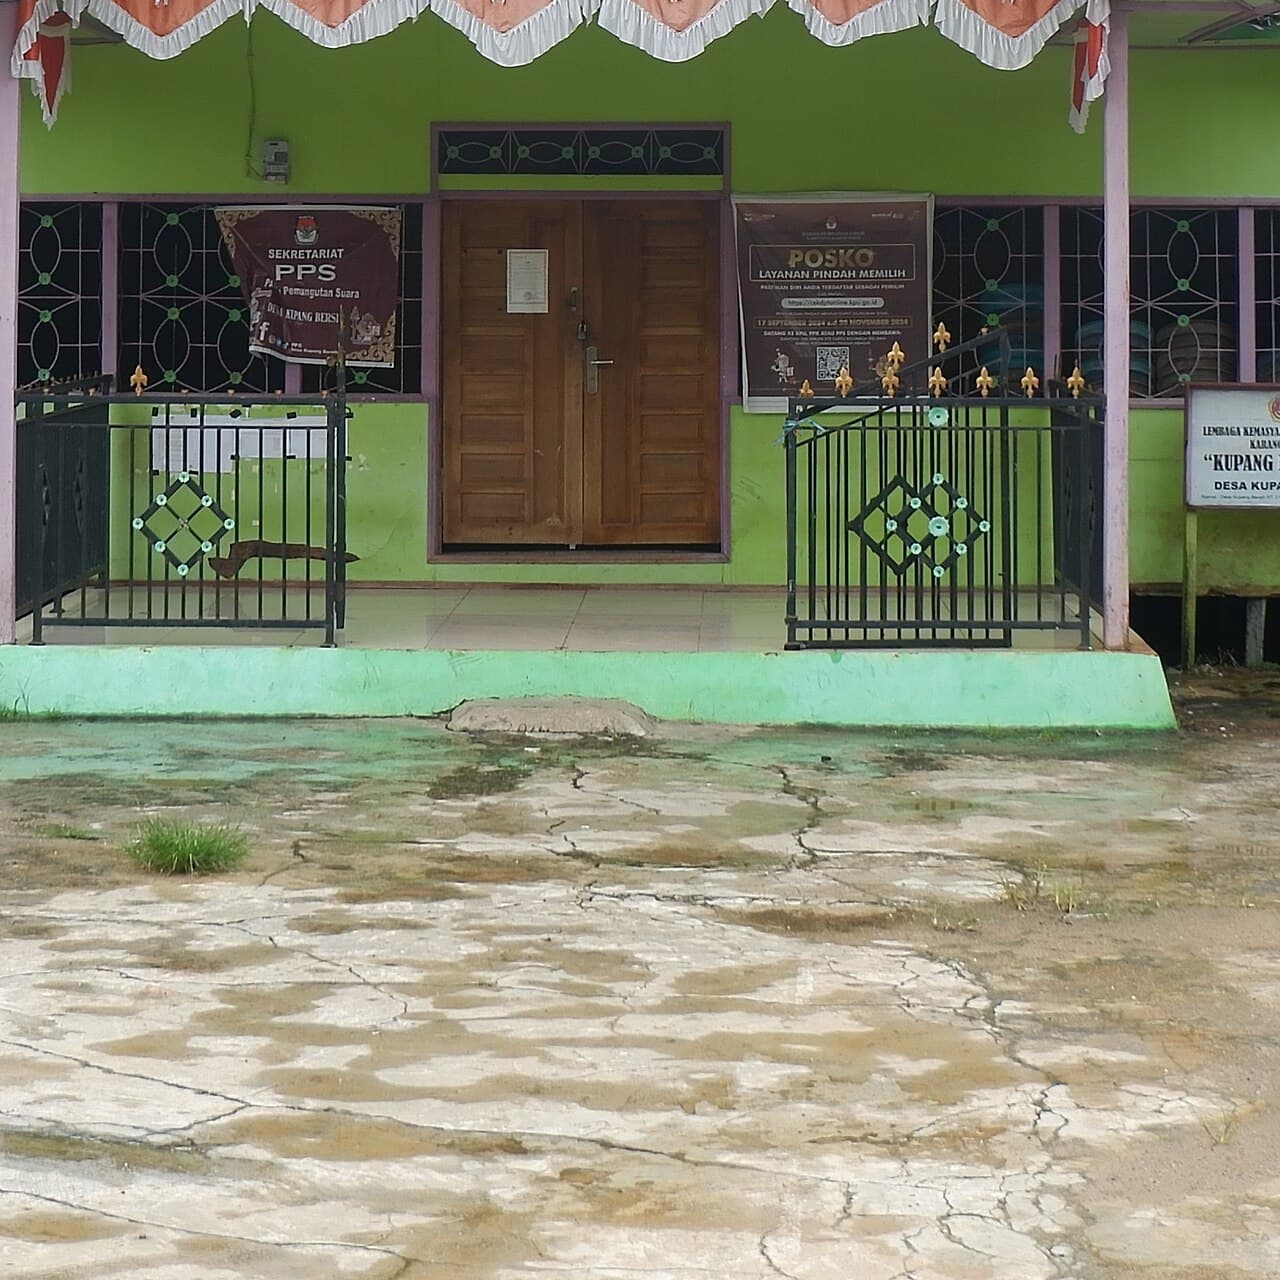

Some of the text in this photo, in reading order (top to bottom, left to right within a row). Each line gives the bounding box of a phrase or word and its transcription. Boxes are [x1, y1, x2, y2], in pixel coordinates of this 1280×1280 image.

[268, 248, 344, 260] SEKRETARIAT
[788, 248, 875, 268] POSKO
[275, 264, 337, 281] PPS
[759, 269, 906, 279] LAYANAN PINDAH MEMILIH
[335, 288, 360, 299] Suara
[315, 312, 340, 324] BERSI
[1203, 426, 1241, 437] LEMBAGA
[1214, 481, 1248, 491] DESA
